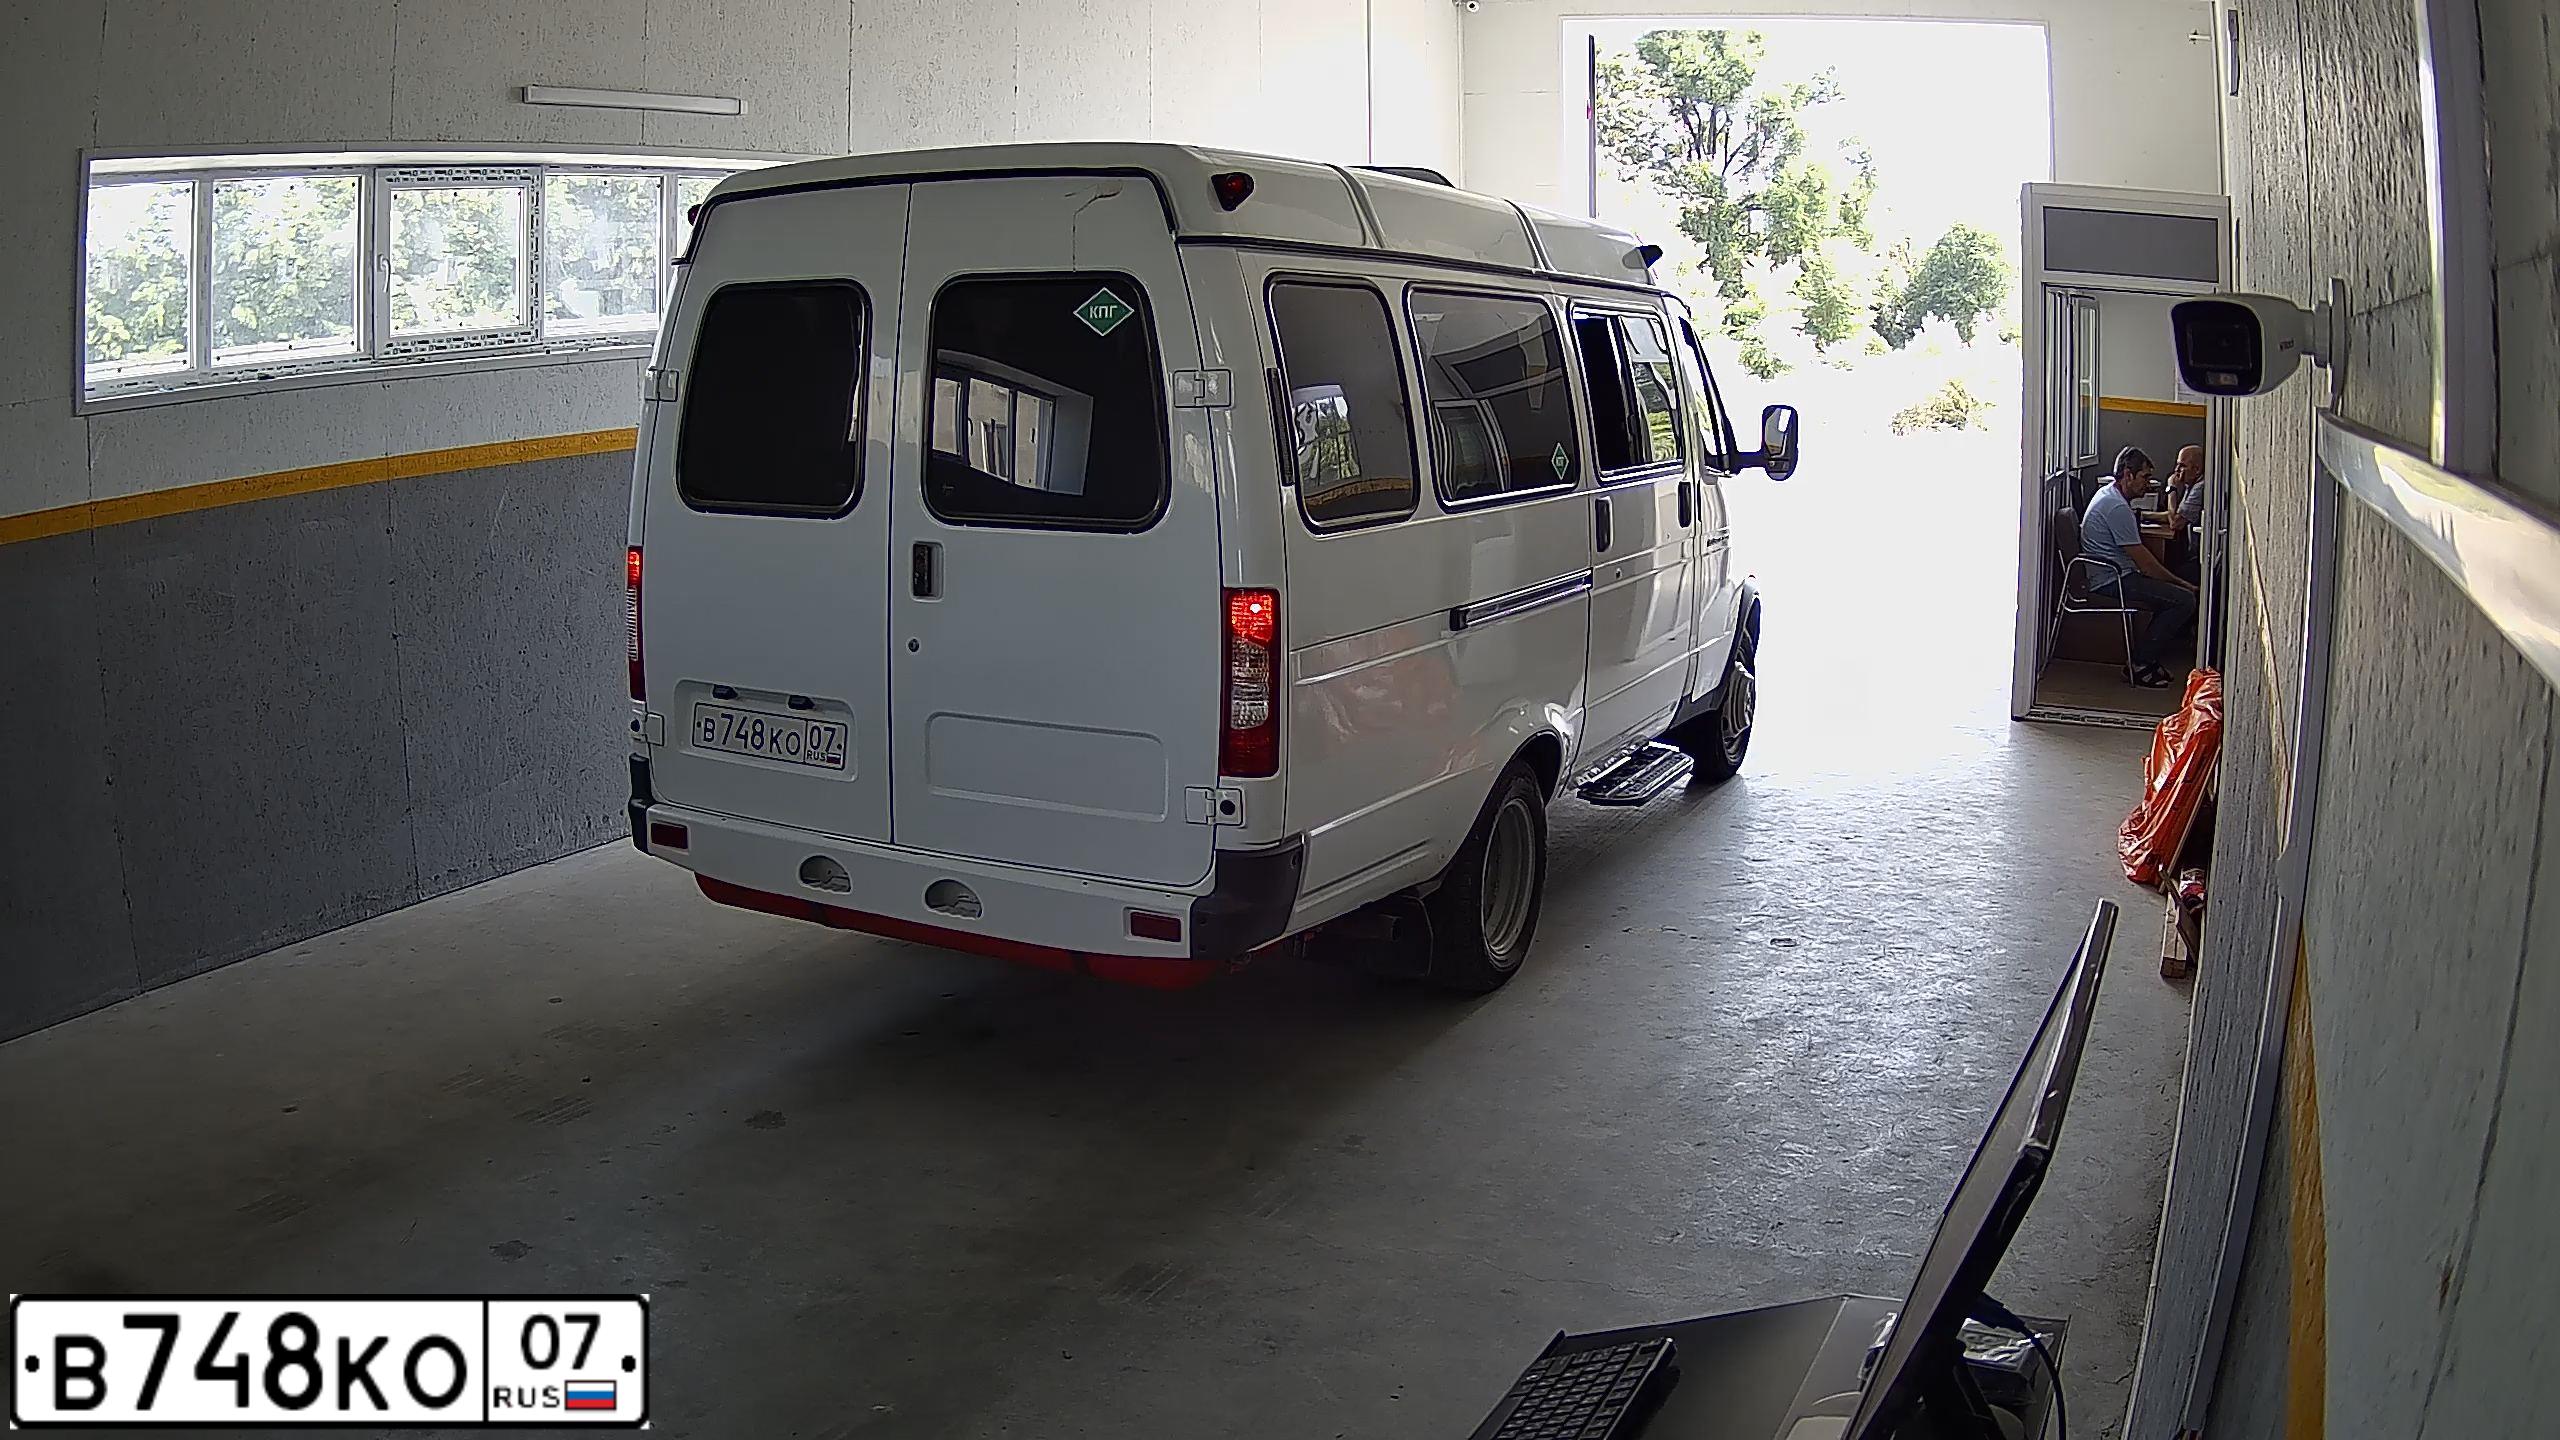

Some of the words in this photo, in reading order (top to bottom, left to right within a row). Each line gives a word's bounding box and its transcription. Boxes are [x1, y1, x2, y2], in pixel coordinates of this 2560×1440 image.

[1089, 305, 1118, 319] КПГ
[809, 725, 837, 753] 07
[806, 749, 826, 762] RUS
